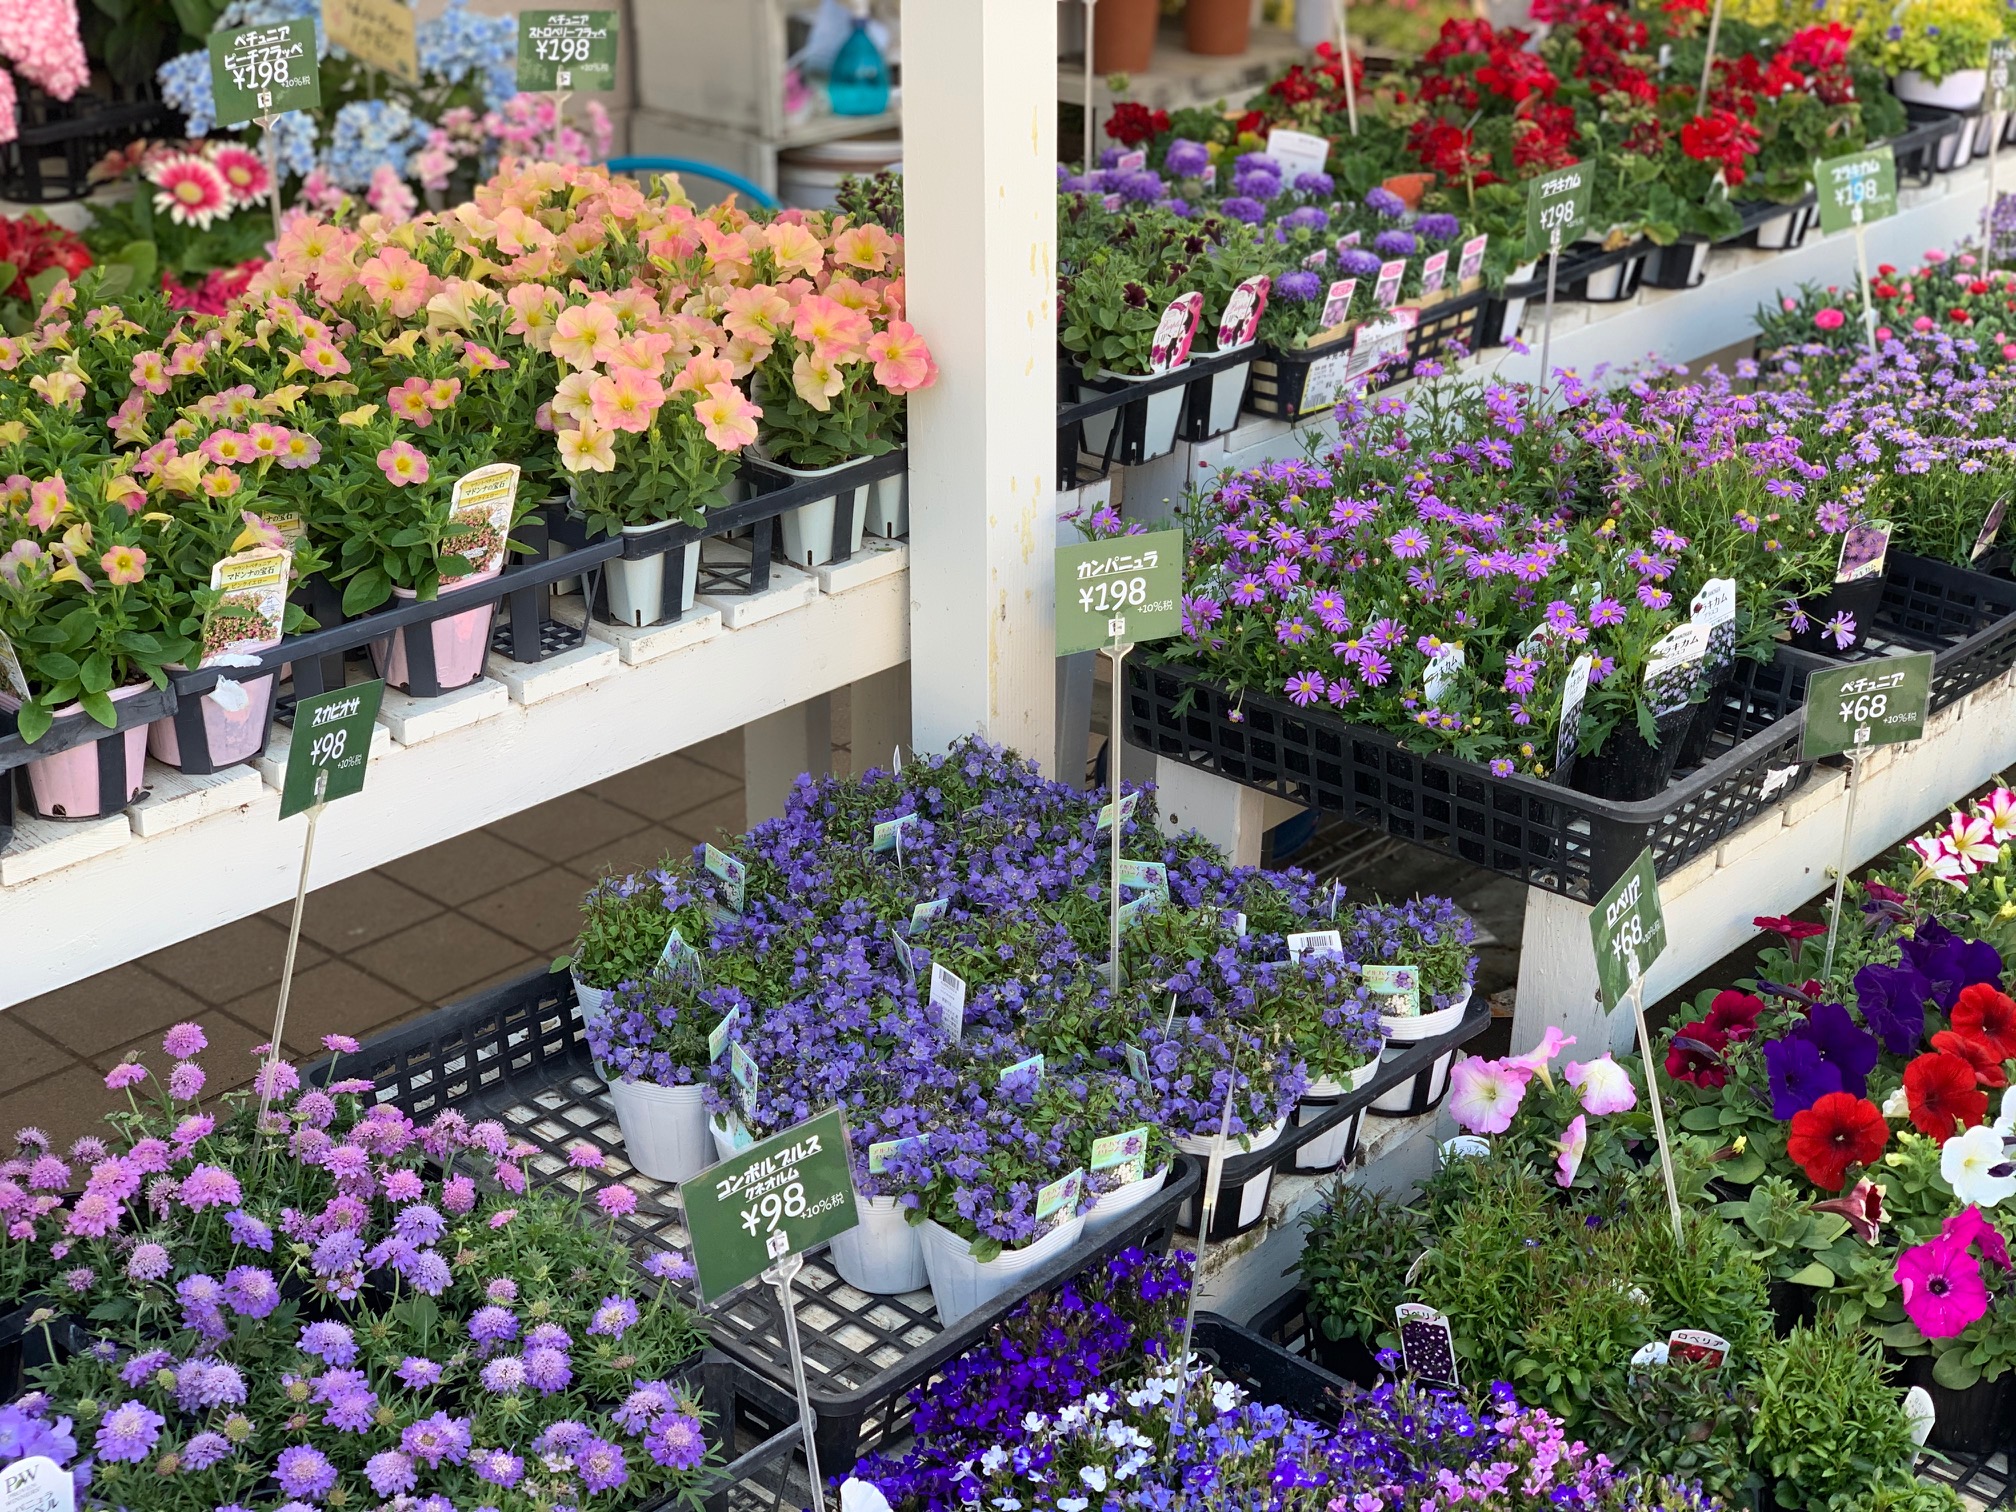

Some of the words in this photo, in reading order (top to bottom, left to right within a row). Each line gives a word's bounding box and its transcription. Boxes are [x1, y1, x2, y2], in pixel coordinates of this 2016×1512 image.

[548, 14, 590, 26] ペチュニア
[234, 25, 290, 47] ペチュニア
[225, 42, 303, 69] ピーチフラッペ
[535, 38, 590, 63] ¥198
[233, 59, 289, 91] ¥198
[1541, 173, 1581, 197] ブラキカム
[1835, 179, 1876, 207] ¥198
[1540, 200, 1574, 230] ¥198
[465, 480, 506, 497] マドンナの宝石
[227, 565, 276, 581] マドンナの宝石
[1077, 551, 1158, 578] カンパニュラ
[231, 579, 268, 590] ピンクイエロー
[1079, 577, 1147, 613] ¥198
[1138, 600, 1173, 613] +10%税
[1841, 672, 1905, 693] ペチュニア
[312, 697, 360, 726] スカビオサ
[1839, 694, 1887, 722] ¥68
[1883, 712, 1917, 724] +10%税
[310, 729, 347, 766] ¥98
[1606, 874, 1640, 927] ロベリア
[1612, 914, 1643, 962] ¥68
[716, 1134, 822, 1199] コンボルブルス
[745, 1167, 799, 1199] クネオルム
[740, 1183, 807, 1237] ¥98
[800, 1192, 844, 1220] +10%税
[1678, 1333, 1723, 1347] ロベリア
[5, 1464, 39, 1493] PW
